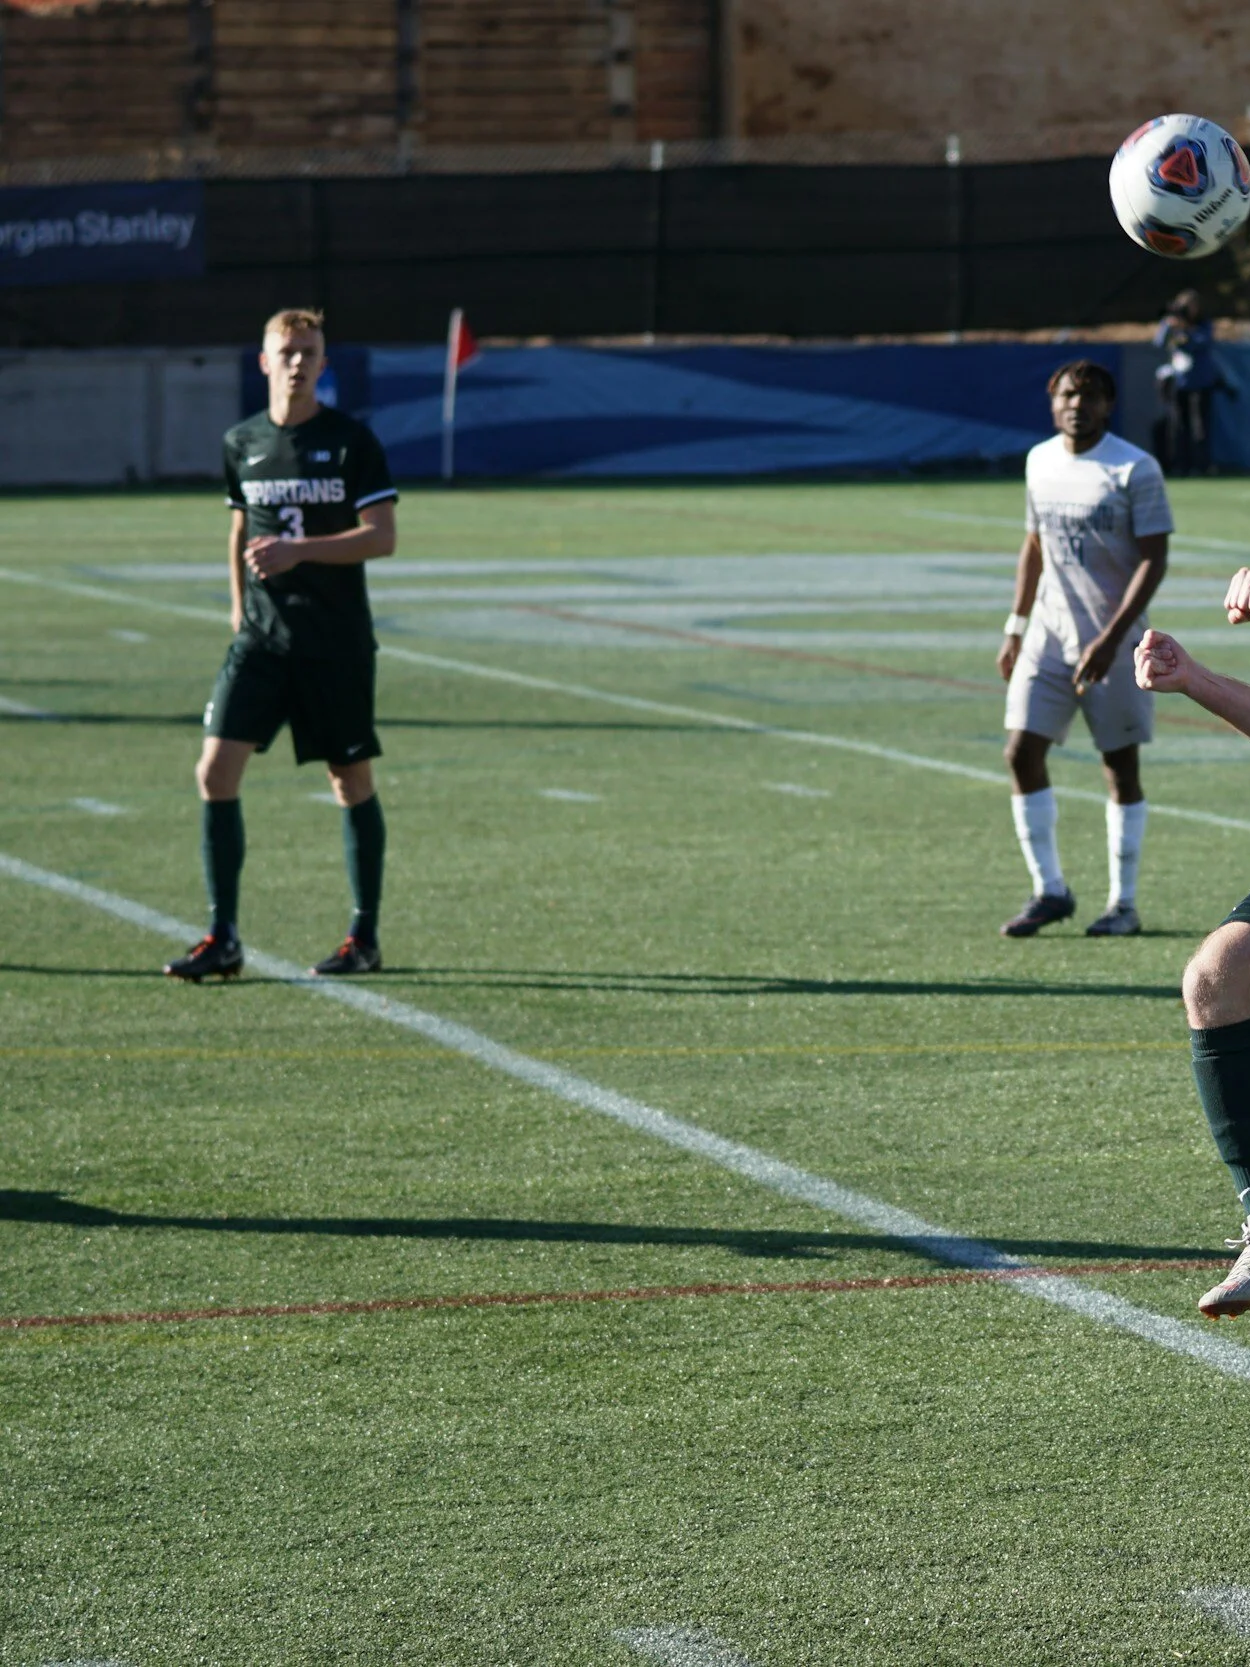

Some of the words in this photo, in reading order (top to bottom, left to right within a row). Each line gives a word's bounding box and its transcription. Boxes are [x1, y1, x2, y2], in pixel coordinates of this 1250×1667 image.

[0, 219, 74, 258] rgan
[76, 208, 196, 250] Stanley
[240, 477, 346, 506] SPARTANS
[278, 505, 305, 541] 3
